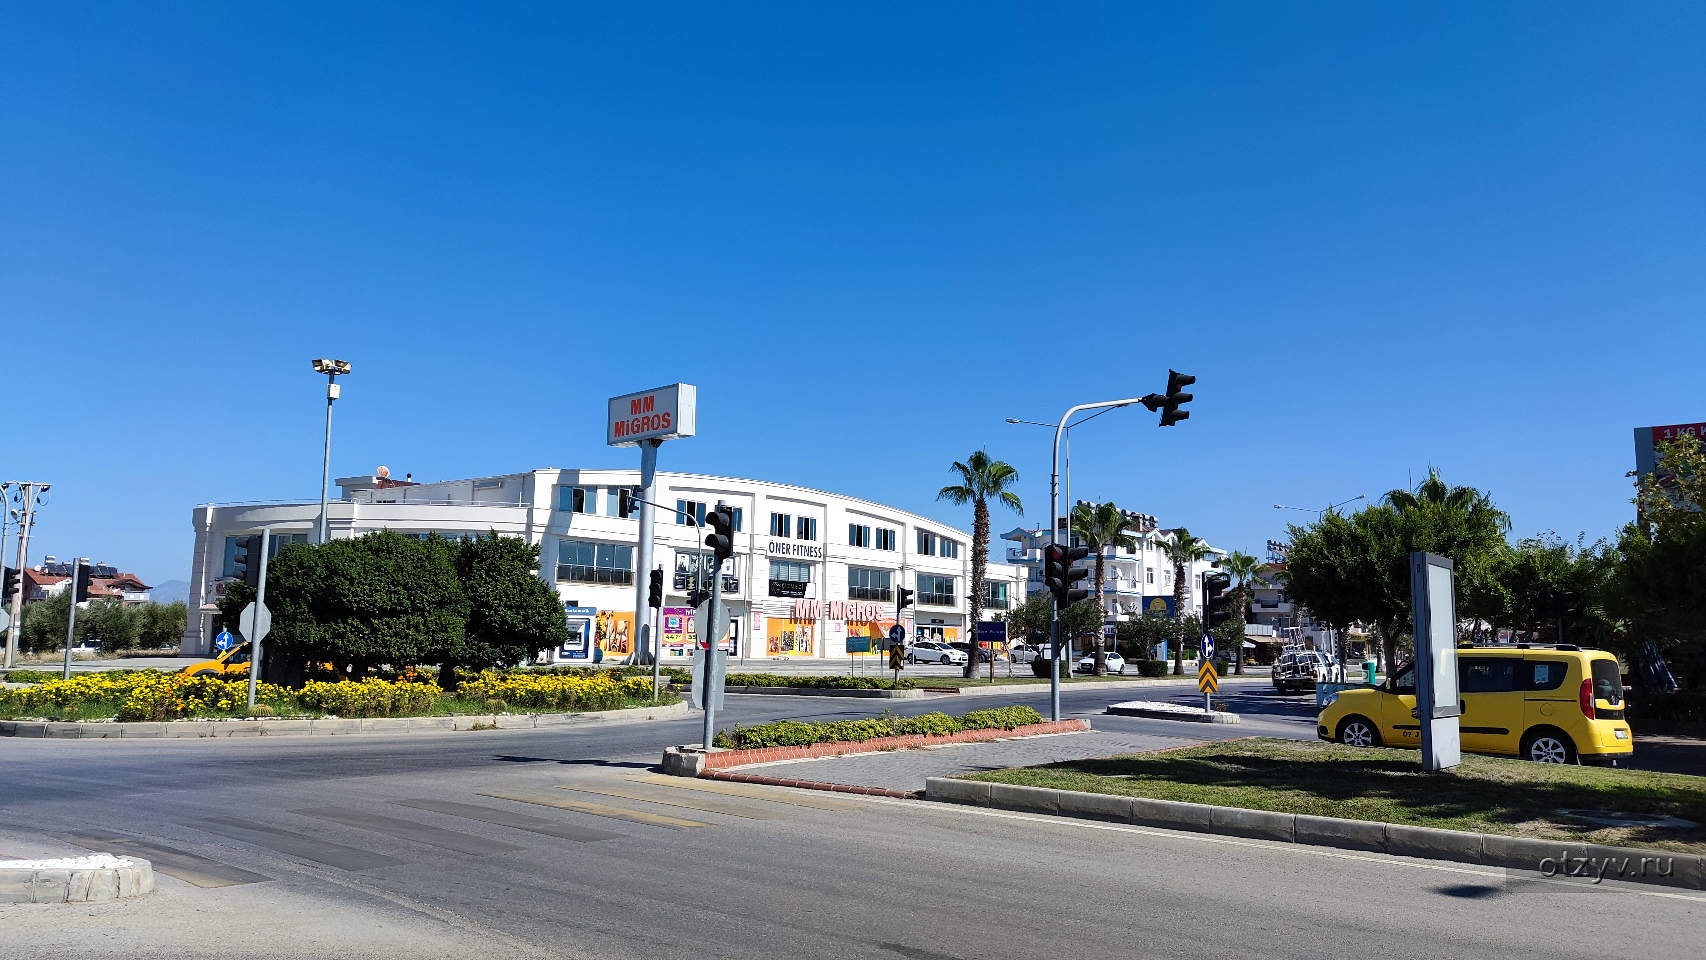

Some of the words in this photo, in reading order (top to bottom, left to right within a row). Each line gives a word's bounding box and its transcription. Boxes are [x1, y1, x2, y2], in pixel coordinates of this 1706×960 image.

[630, 395, 655, 416] MM
[792, 544, 822, 558] FITNESS
[795, 599, 823, 619] MM
